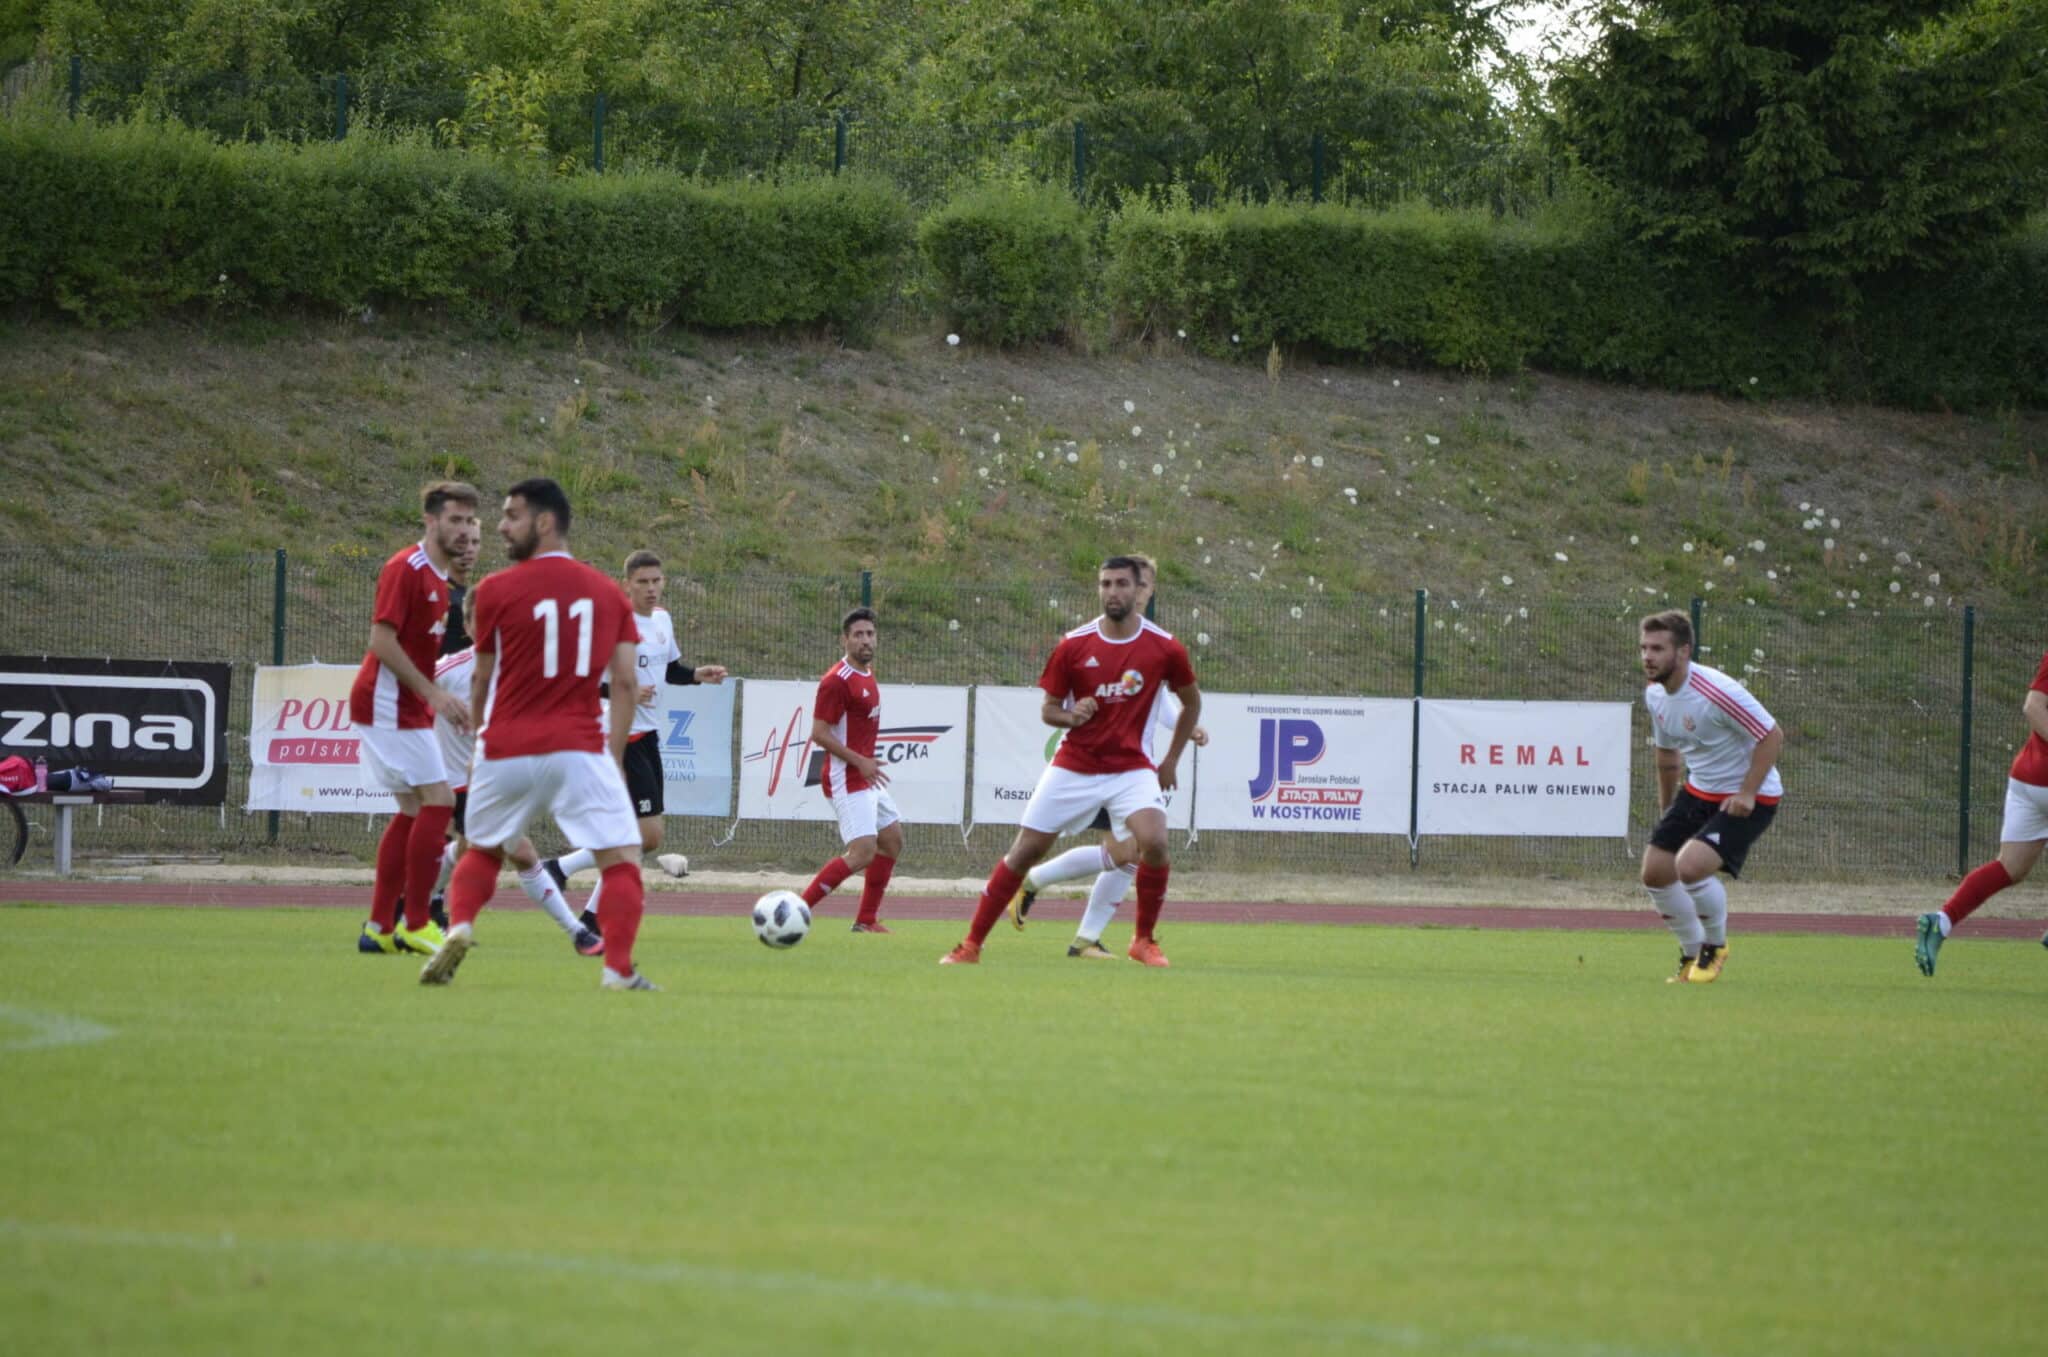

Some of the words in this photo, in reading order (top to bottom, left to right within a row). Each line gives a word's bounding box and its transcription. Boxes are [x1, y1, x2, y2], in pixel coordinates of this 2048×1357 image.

[533, 598, 594, 678] 11
[1, 711, 193, 750] zina
[1248, 719, 1326, 802] JP
[1461, 744, 1589, 766] REMAL
[994, 786, 1036, 801] Kaszu
[1281, 789, 1320, 803] STACJA
[1322, 791, 1359, 802] PALIW
[1434, 783, 1487, 794] STACJA
[1496, 784, 1538, 795] PALIW
[1546, 784, 1615, 796] GNIEWINO
[1252, 805, 1266, 818] W
[1271, 806, 1361, 820] KOSTKOWIE
